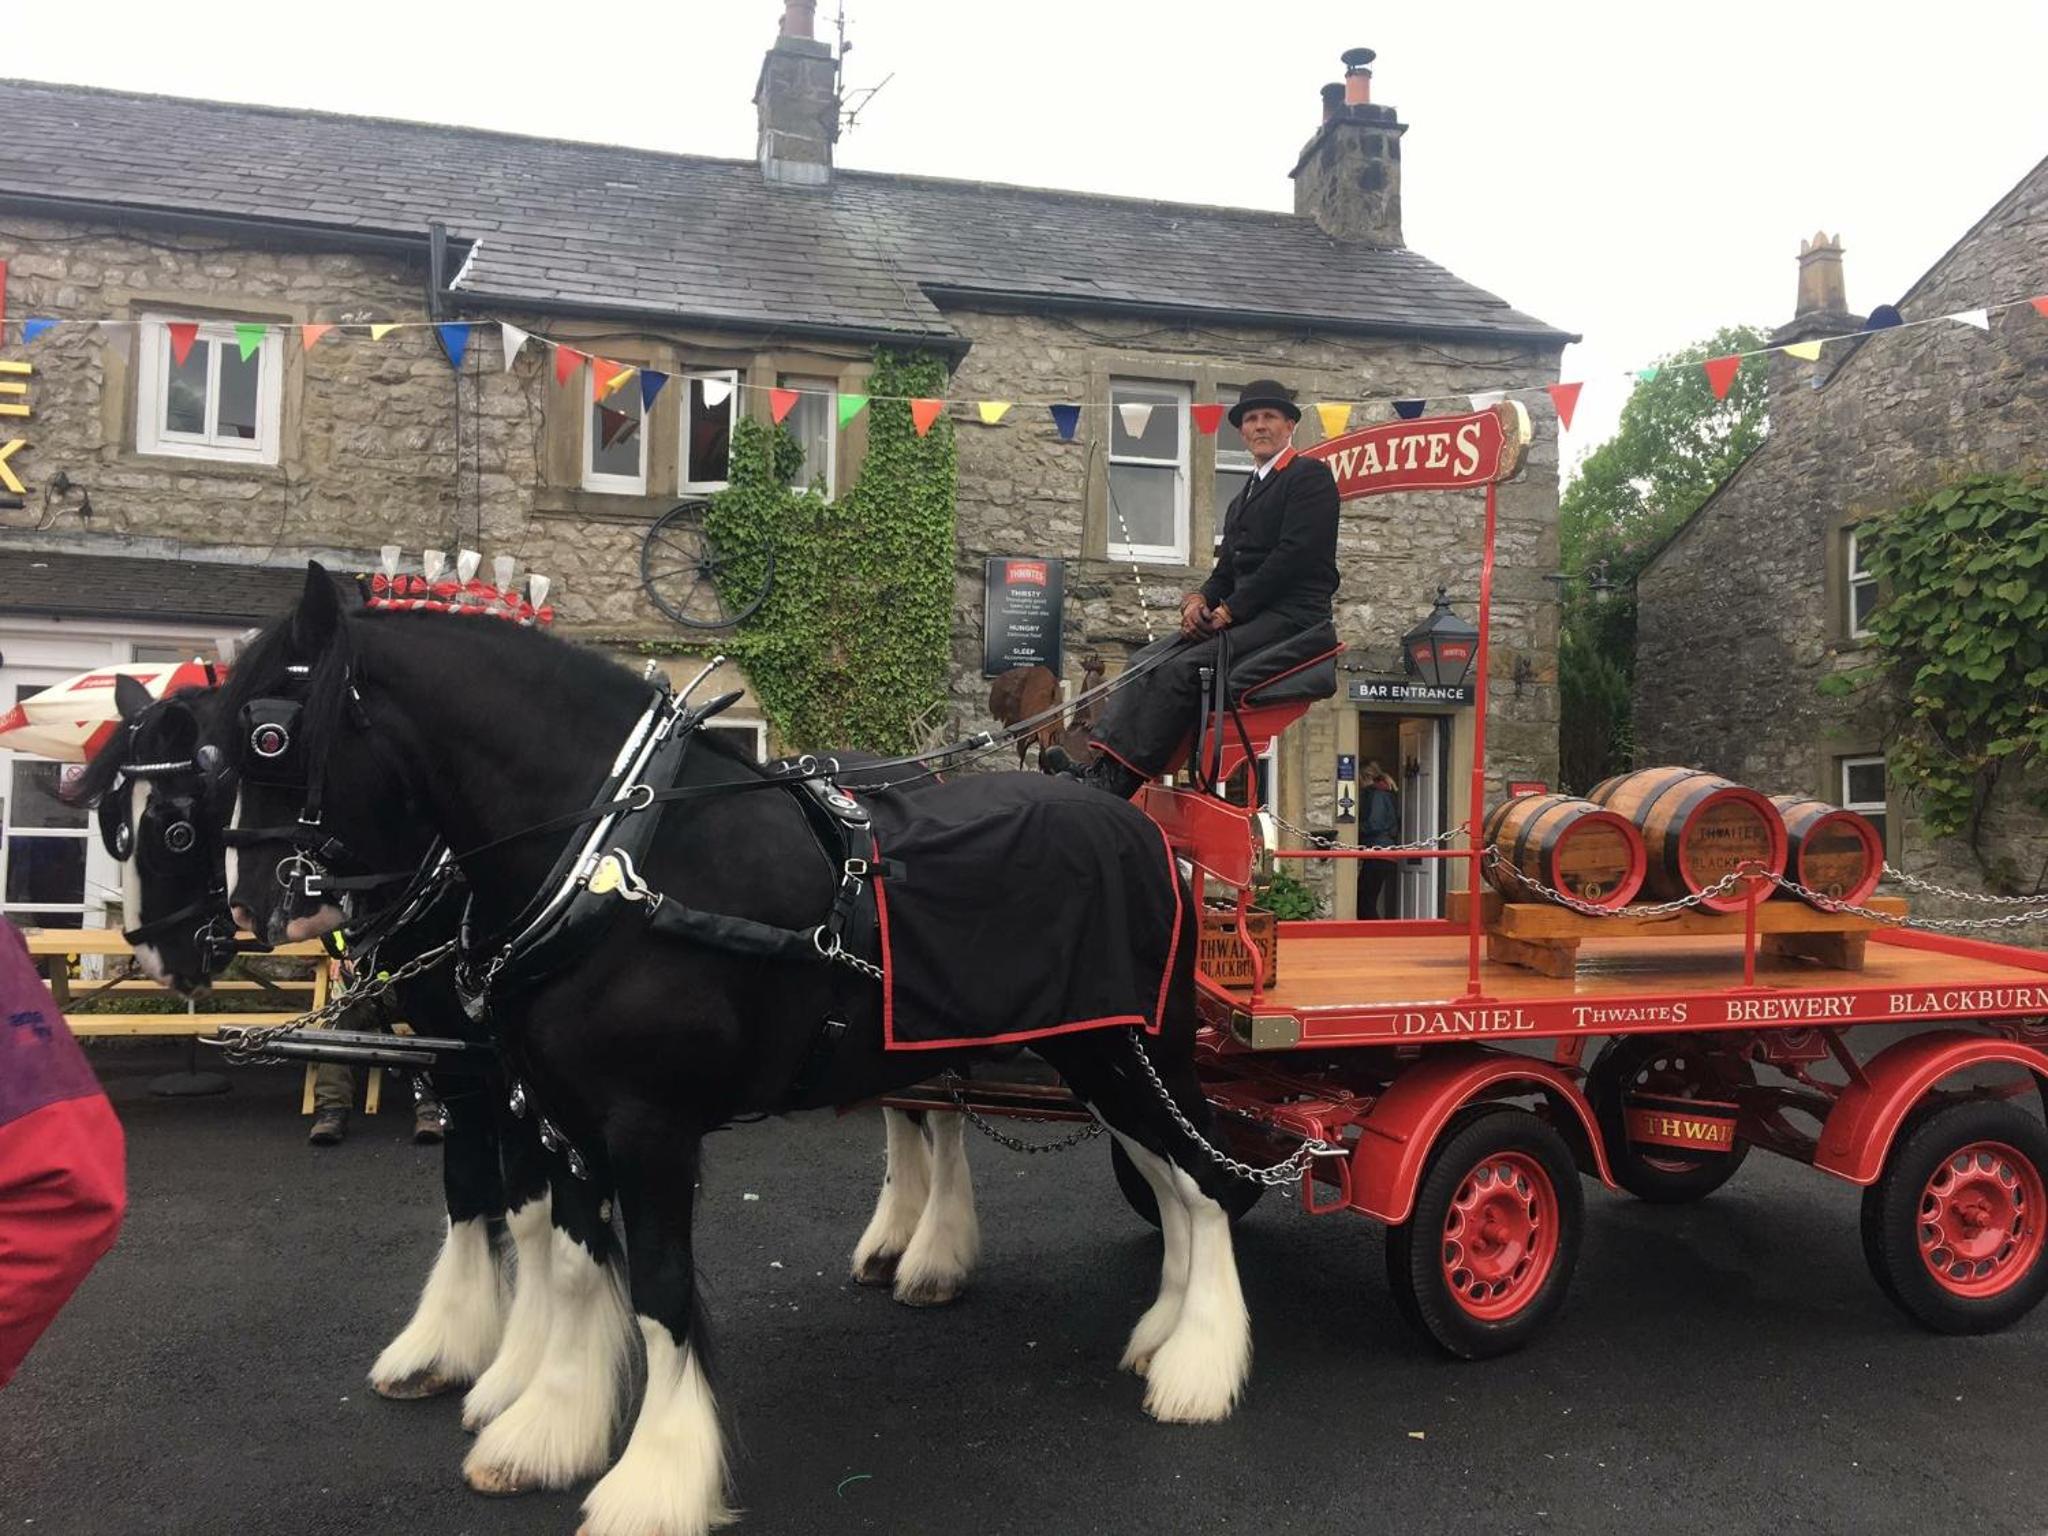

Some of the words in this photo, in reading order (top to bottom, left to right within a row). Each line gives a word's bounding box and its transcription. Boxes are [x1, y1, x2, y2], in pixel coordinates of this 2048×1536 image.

[1320, 421, 1481, 483] WAITES
[1008, 624, 1040, 632] HUNGRY
[1360, 685, 1387, 697] BAR
[1392, 686, 1464, 699] ENTRANCE
[1402, 1009, 1535, 1035] DANIEL
[1726, 996, 1856, 1021] BREWERY
[1889, 988, 2048, 1014] BLACKBURN
